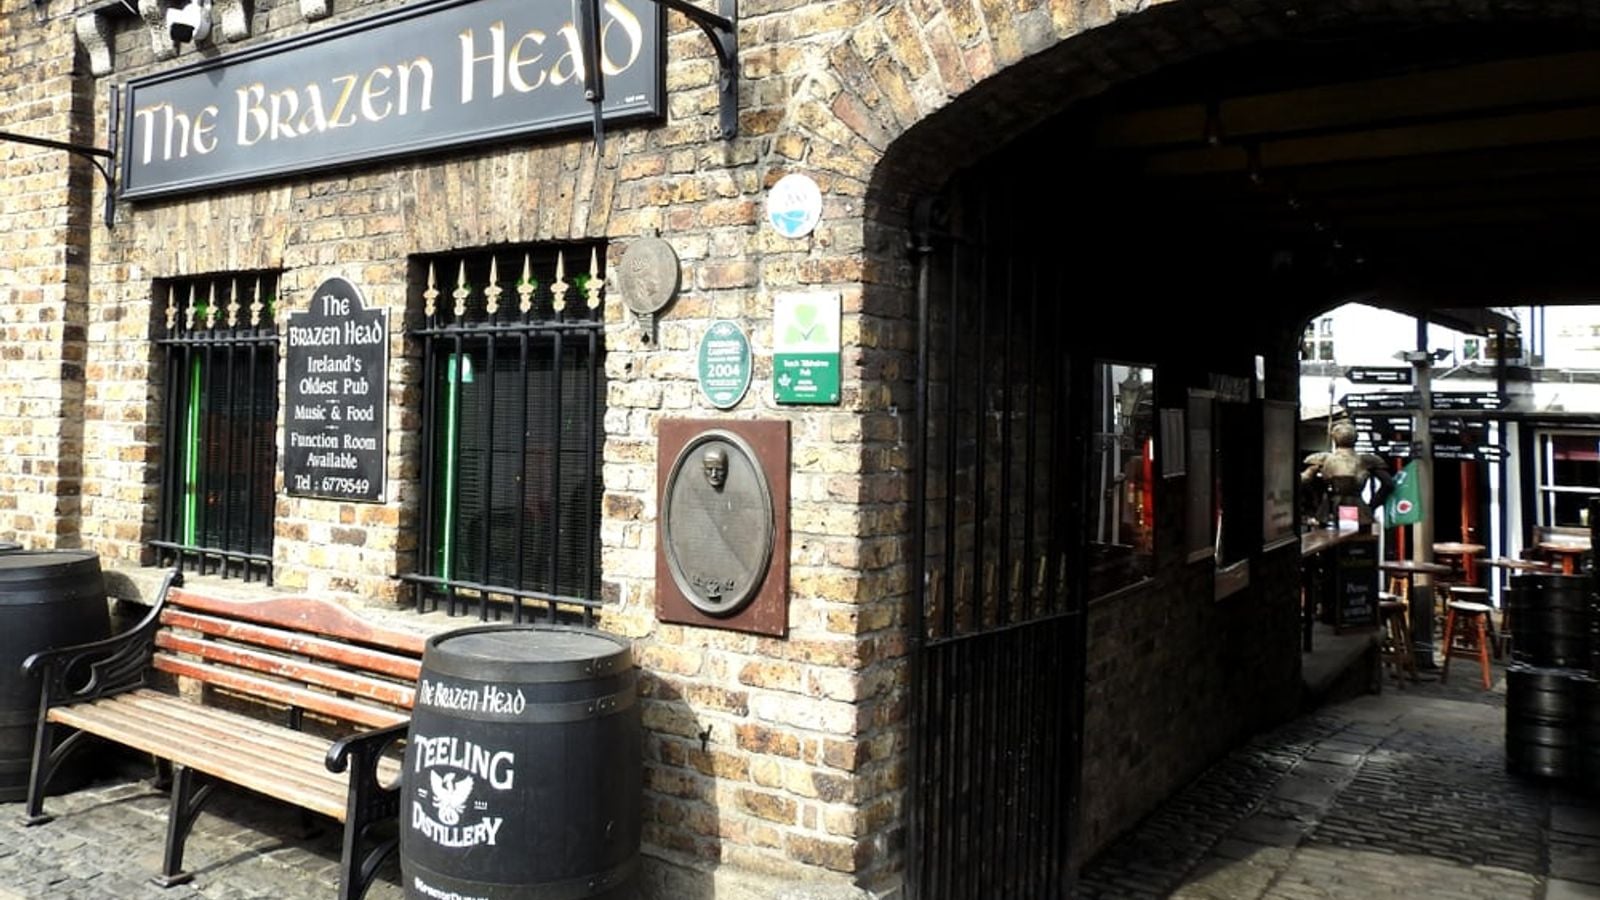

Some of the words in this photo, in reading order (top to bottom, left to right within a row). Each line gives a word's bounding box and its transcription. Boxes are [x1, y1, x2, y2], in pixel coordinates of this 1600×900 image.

[136, 103, 218, 164] The
[321, 295, 350, 316] The
[307, 355, 362, 373] Ireland's
[707, 364, 740, 377] 2004
[299, 378, 338, 395] Oldest
[343, 378, 369, 395] Pub
[294, 404, 327, 420] Music
[331, 405, 341, 420] &
[346, 405, 374, 421] Food
[291, 432, 338, 448] Function
[343, 434, 376, 450] Room
[306, 452, 358, 469] Available
[295, 474, 311, 490] Tel
[322, 476, 370, 493] 6779549
[414, 734, 515, 790] TEELING
[412, 801, 503, 848] DISTILLERY
